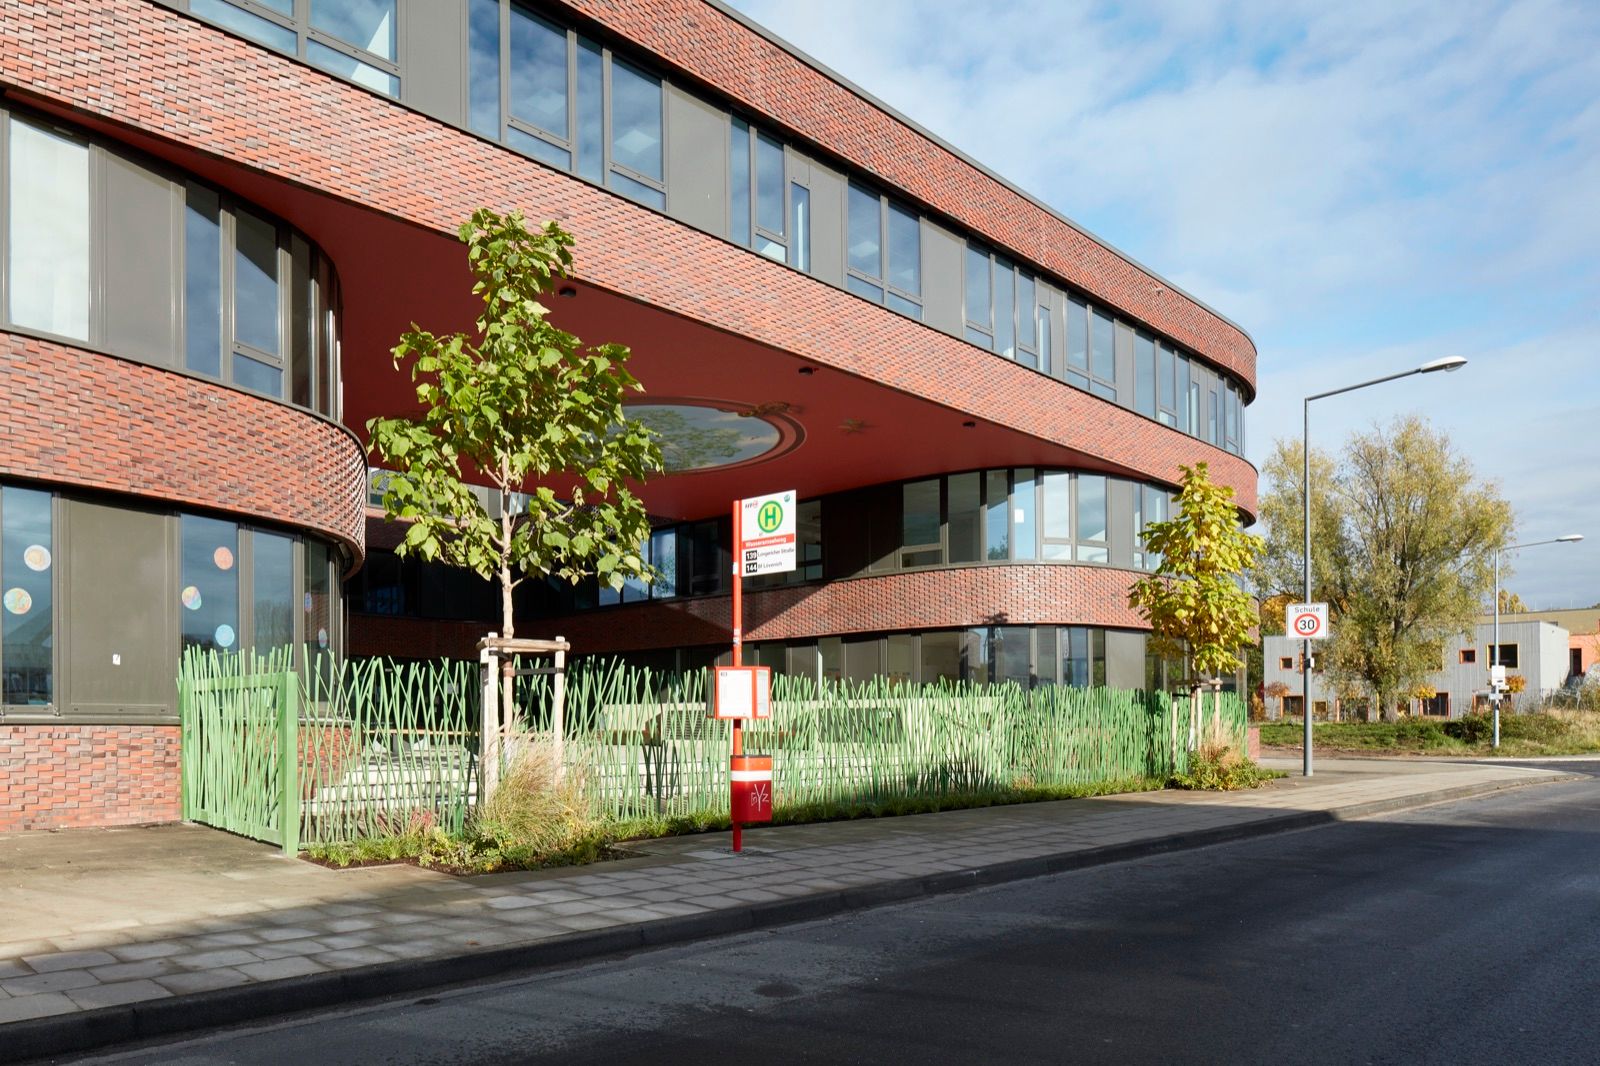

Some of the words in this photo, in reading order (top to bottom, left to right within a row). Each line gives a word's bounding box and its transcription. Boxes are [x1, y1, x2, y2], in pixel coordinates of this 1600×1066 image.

[765, 507, 776, 527] H
[746, 563, 757, 572] 144
[1299, 619, 1314, 630] 30
